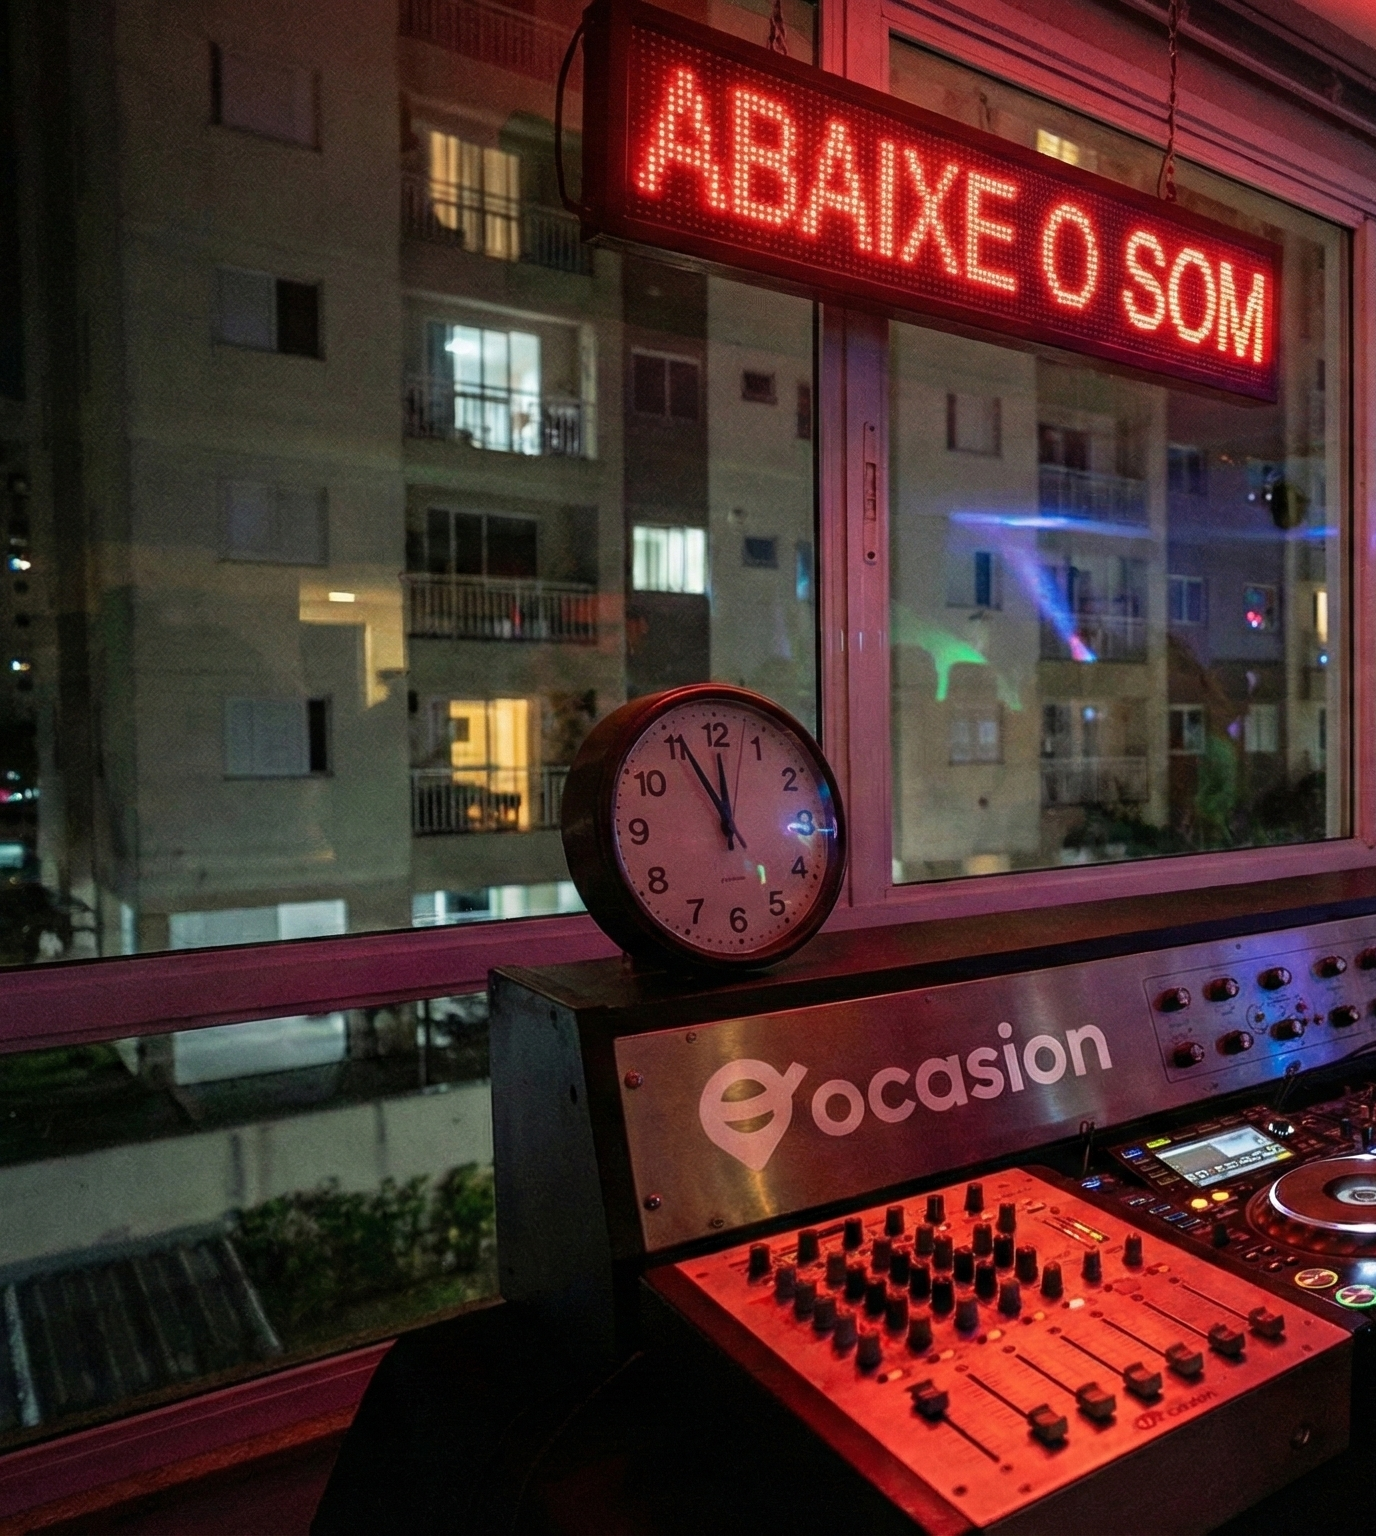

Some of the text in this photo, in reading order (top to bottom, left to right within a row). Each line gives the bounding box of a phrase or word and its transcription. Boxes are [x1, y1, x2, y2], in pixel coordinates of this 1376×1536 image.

[639, 67, 1265, 364] ABAIXE O SOM
[664, 733, 687, 761] 11
[701, 722, 730, 748] 12
[750, 735, 762, 761] 1
[634, 769, 667, 797] 10
[782, 767, 799, 791] 2
[628, 818, 649, 845] 9
[647, 866, 669, 894] 8
[791, 856, 808, 879] 4
[686, 898, 704, 924] 7
[769, 890, 786, 916] 5
[729, 907, 748, 933] 6
[811, 1021, 1113, 1137] ocasion
